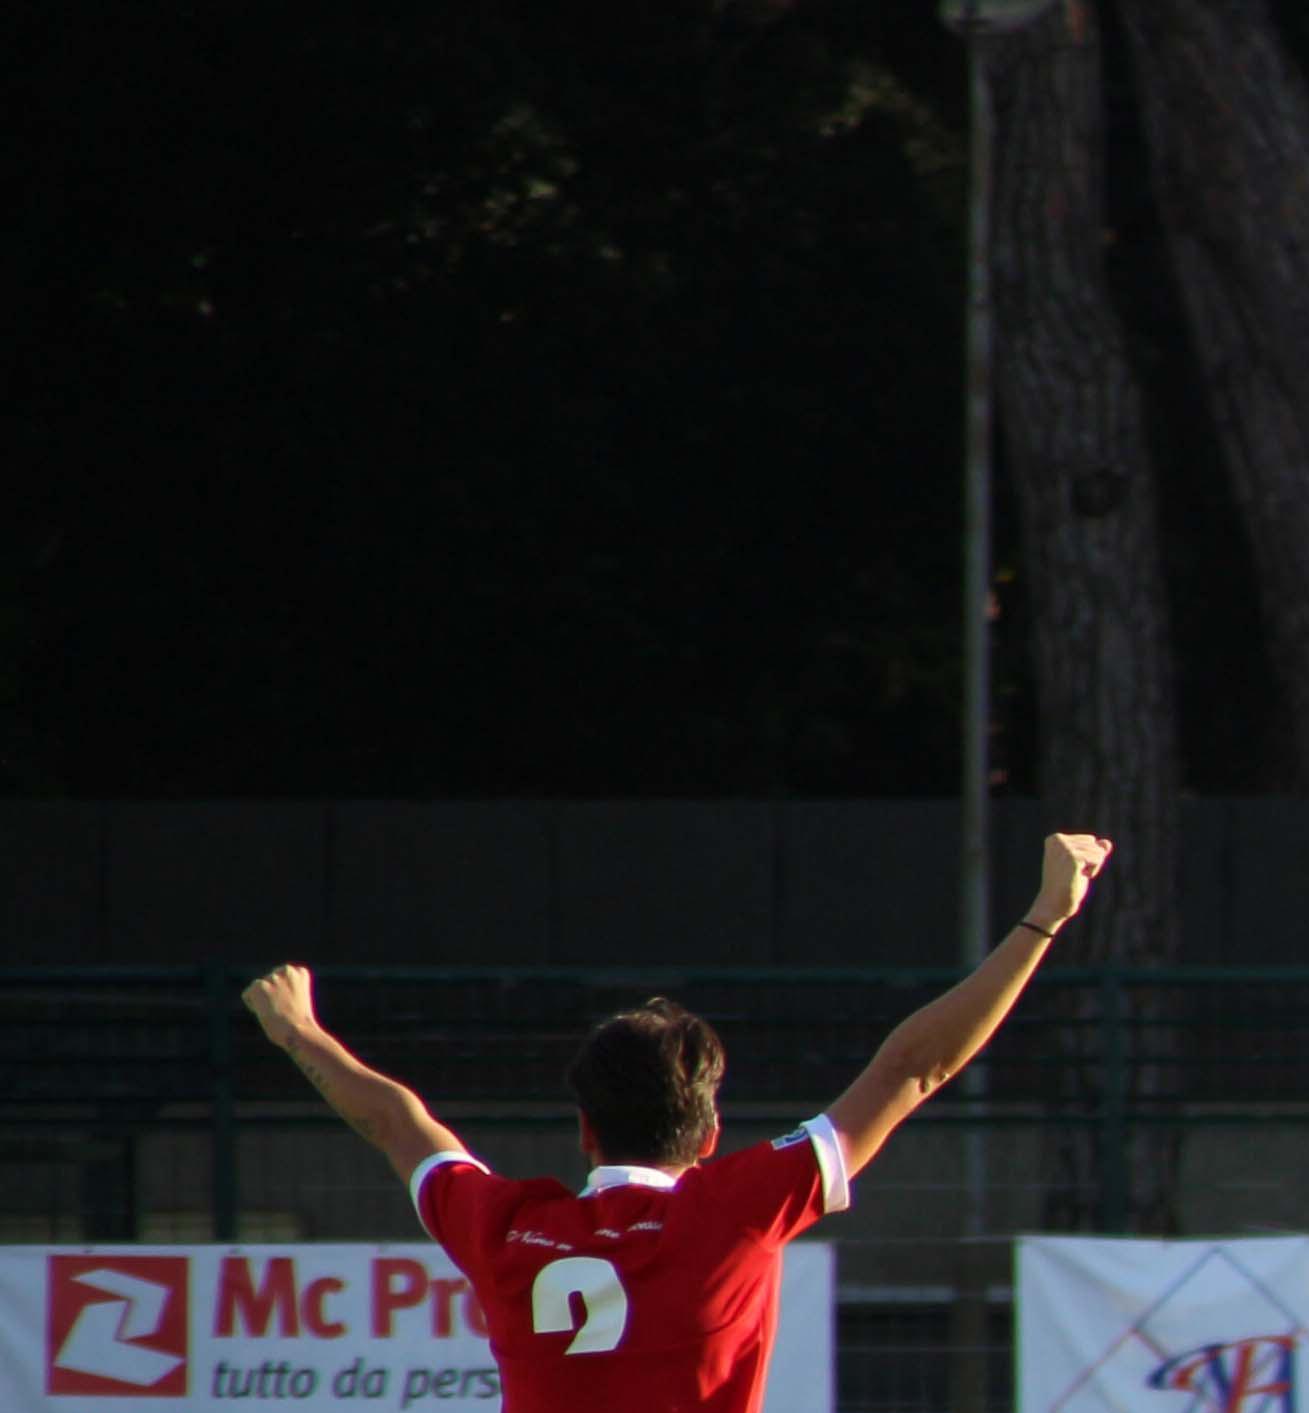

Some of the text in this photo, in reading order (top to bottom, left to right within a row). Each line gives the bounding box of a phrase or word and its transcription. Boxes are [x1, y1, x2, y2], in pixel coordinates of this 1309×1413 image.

[212, 1256, 347, 1338] Mc
[211, 1361, 315, 1399] tutto
[333, 1357, 388, 1399] da
